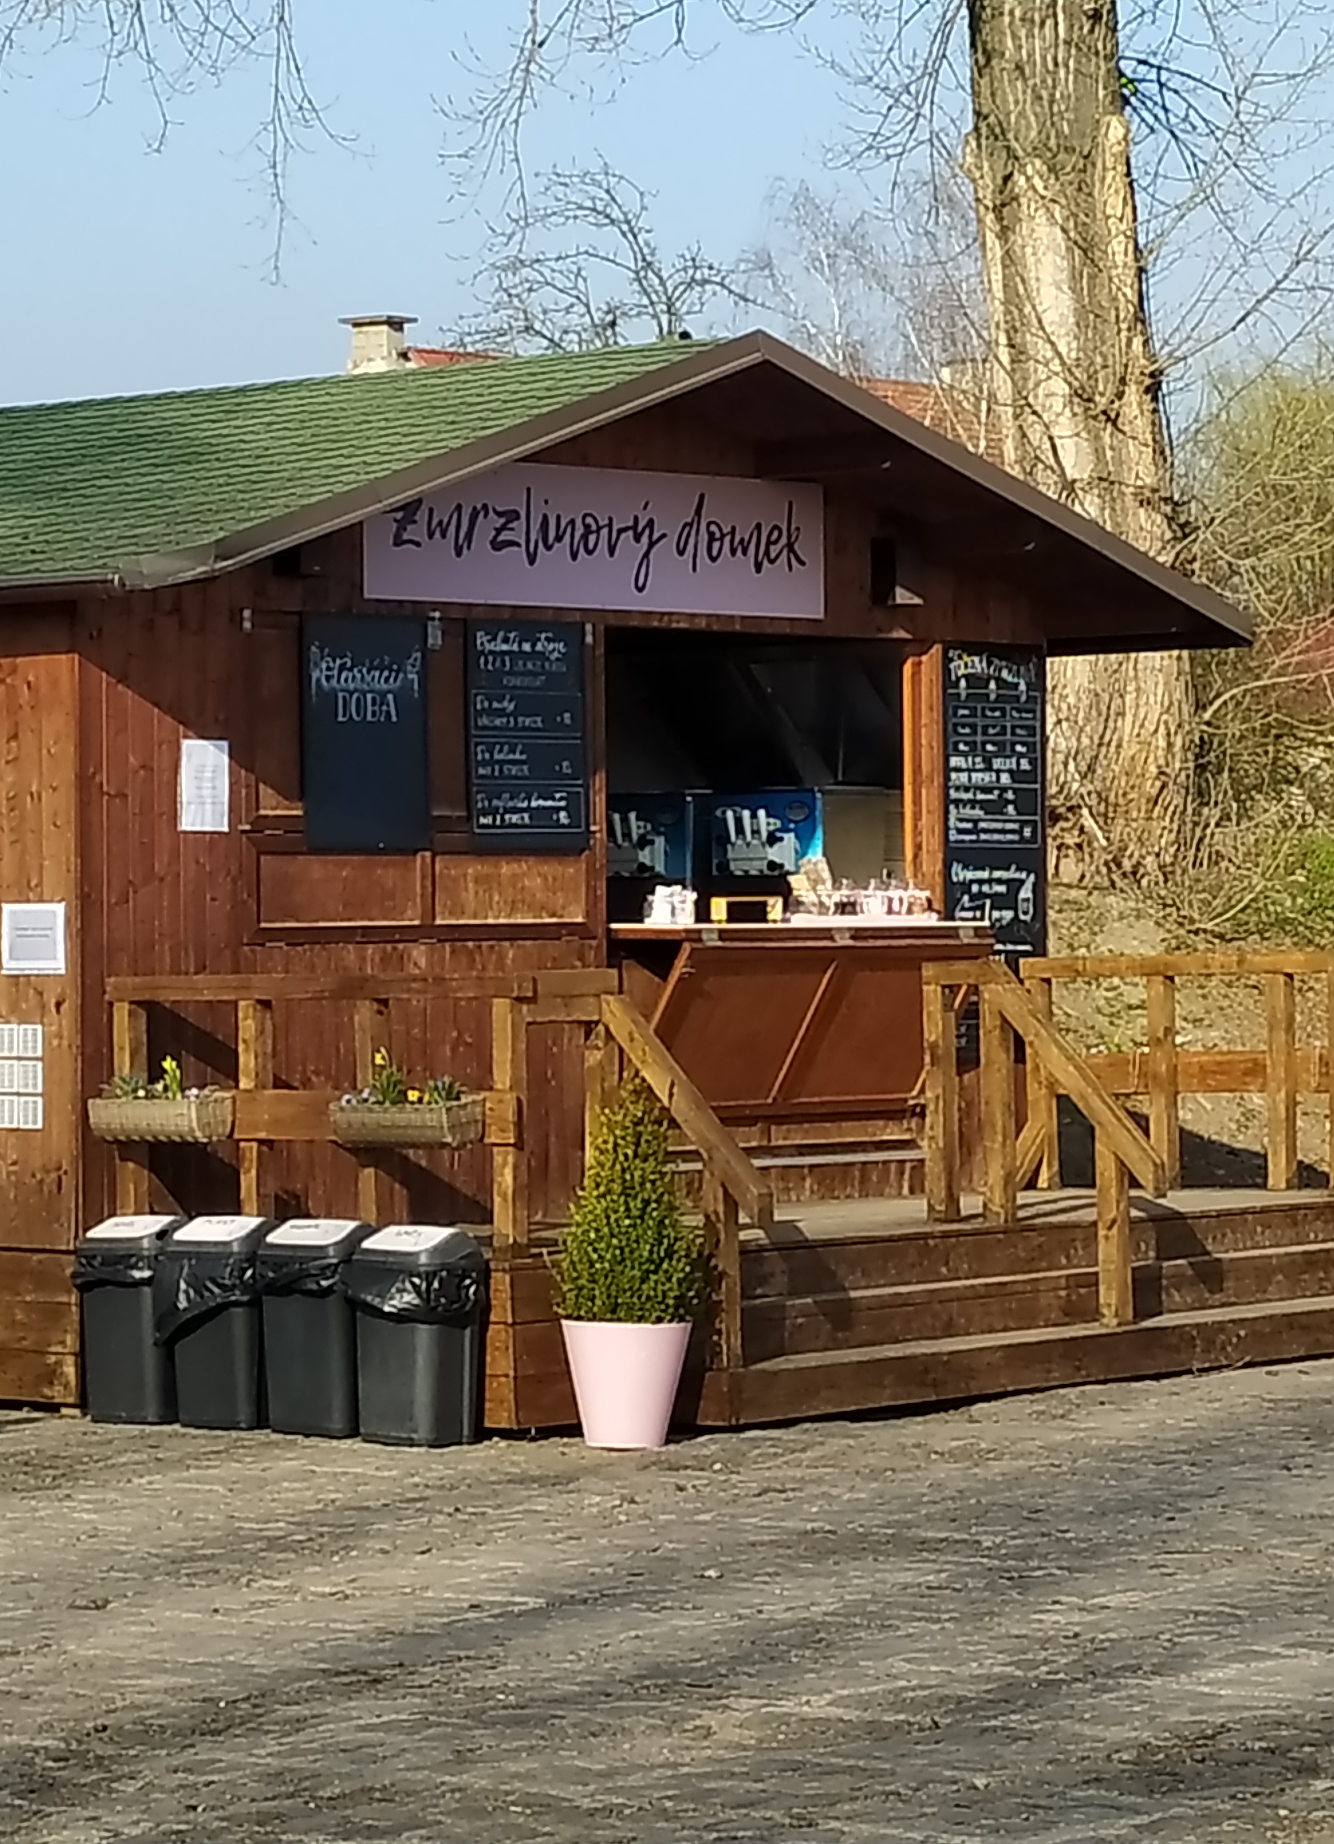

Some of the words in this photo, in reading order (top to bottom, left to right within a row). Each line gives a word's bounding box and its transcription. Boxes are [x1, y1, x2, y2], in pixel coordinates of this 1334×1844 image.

[381, 486, 667, 593] Zmrzlinový
[675, 492, 807, 574] domek
[337, 692, 398, 722] DOBA
